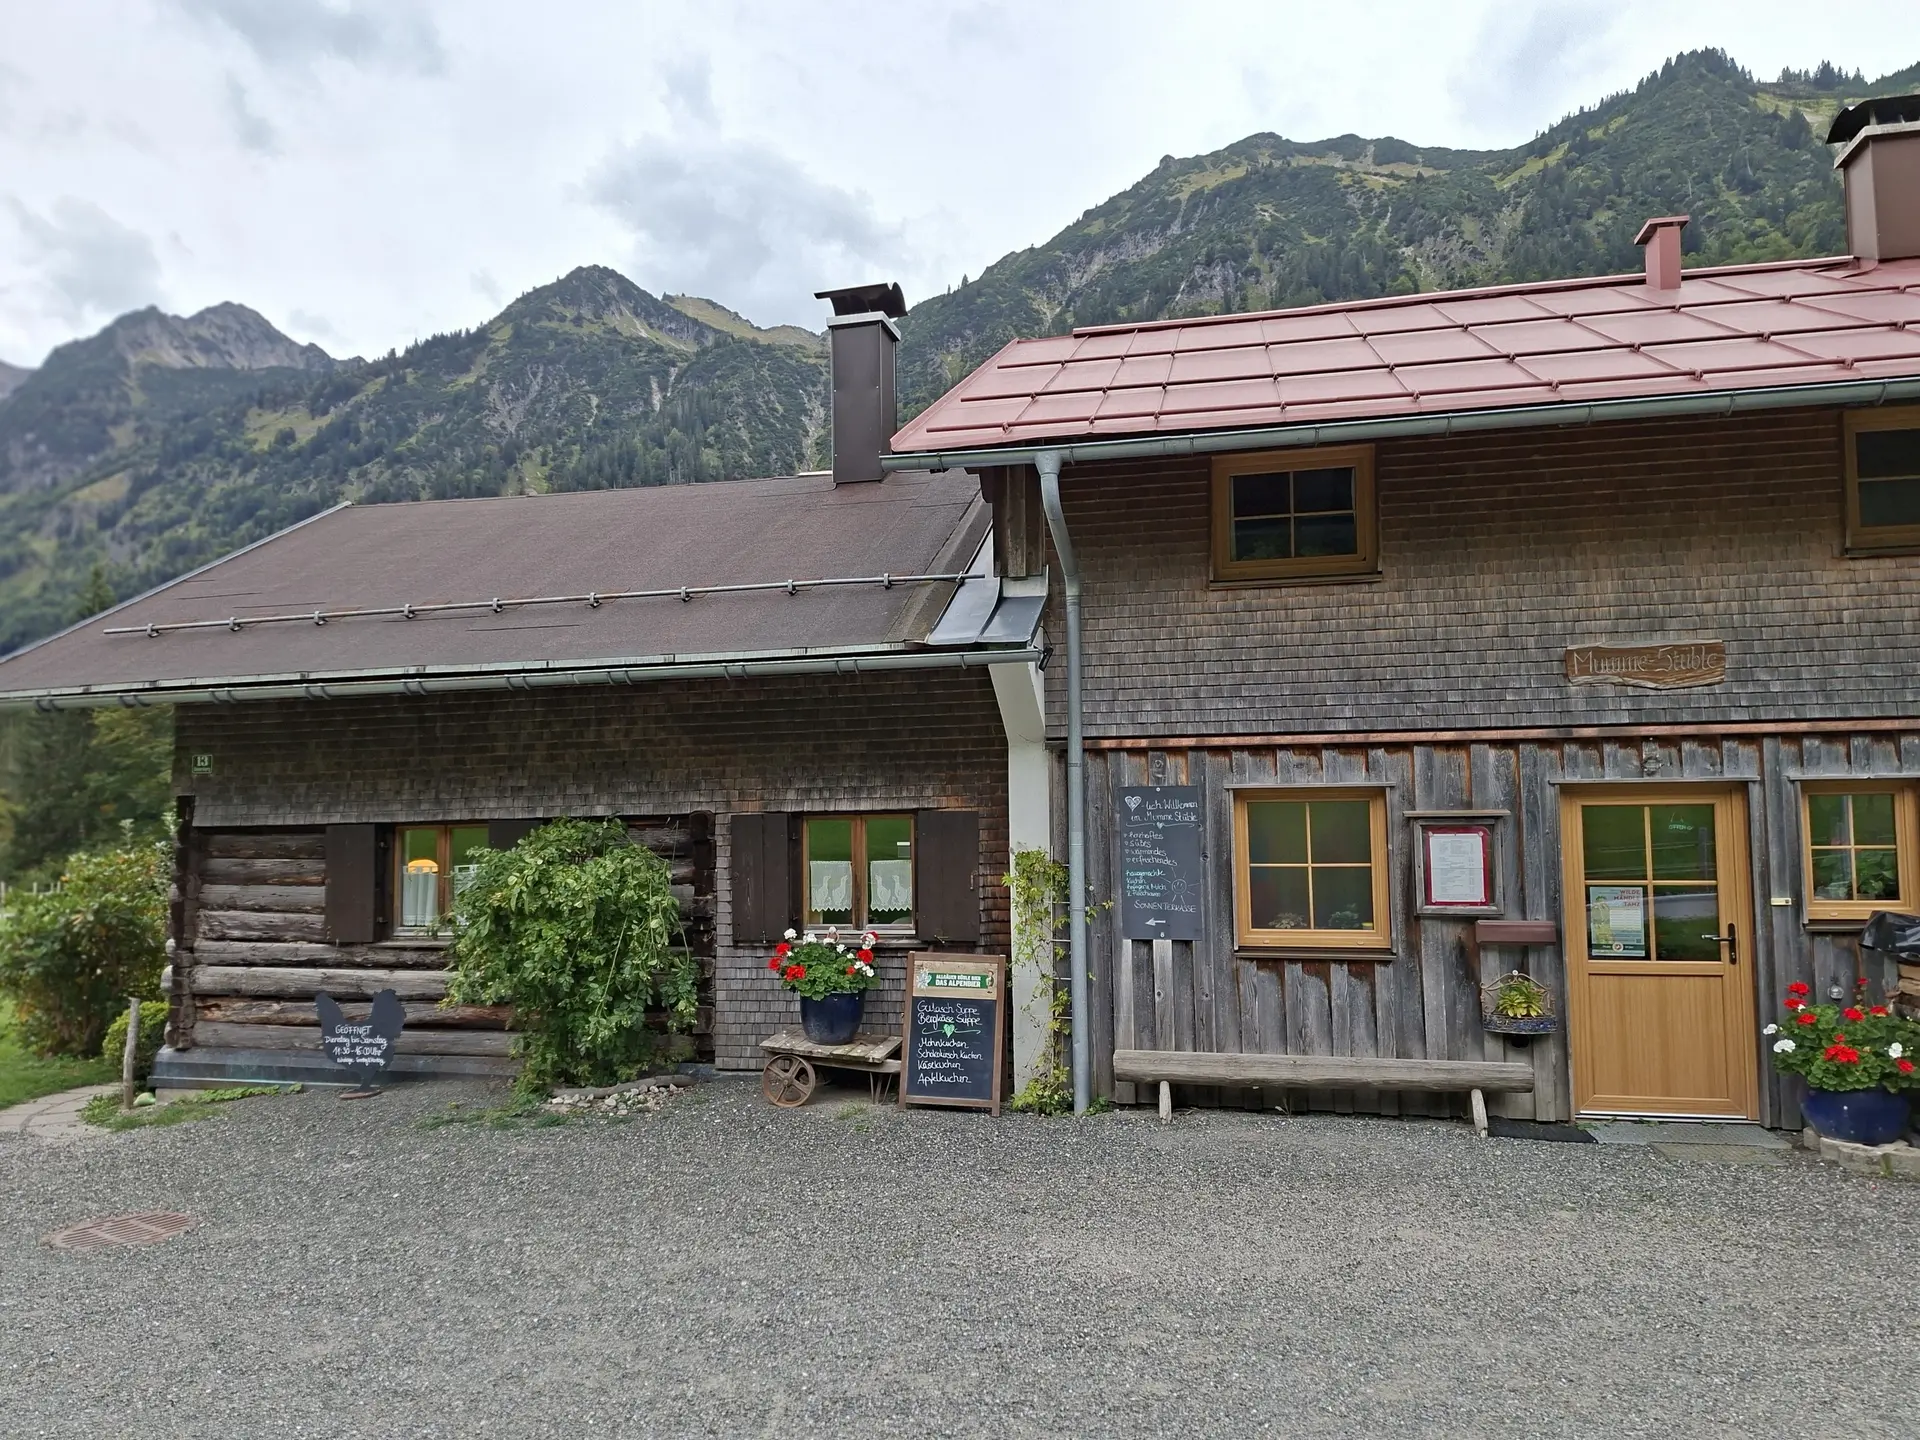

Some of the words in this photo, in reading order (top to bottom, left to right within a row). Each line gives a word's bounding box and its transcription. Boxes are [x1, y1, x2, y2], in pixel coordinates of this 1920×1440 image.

[197, 756, 208, 766] 13
[917, 1000, 954, 1013] Gulasch
[956, 1003, 980, 1017] Suppe
[956, 1014, 982, 1026] Suppe
[335, 1024, 373, 1035] GEÖFFNET
[360, 1032, 388, 1050] Samstag
[371, 1046, 383, 1056] Uhr
